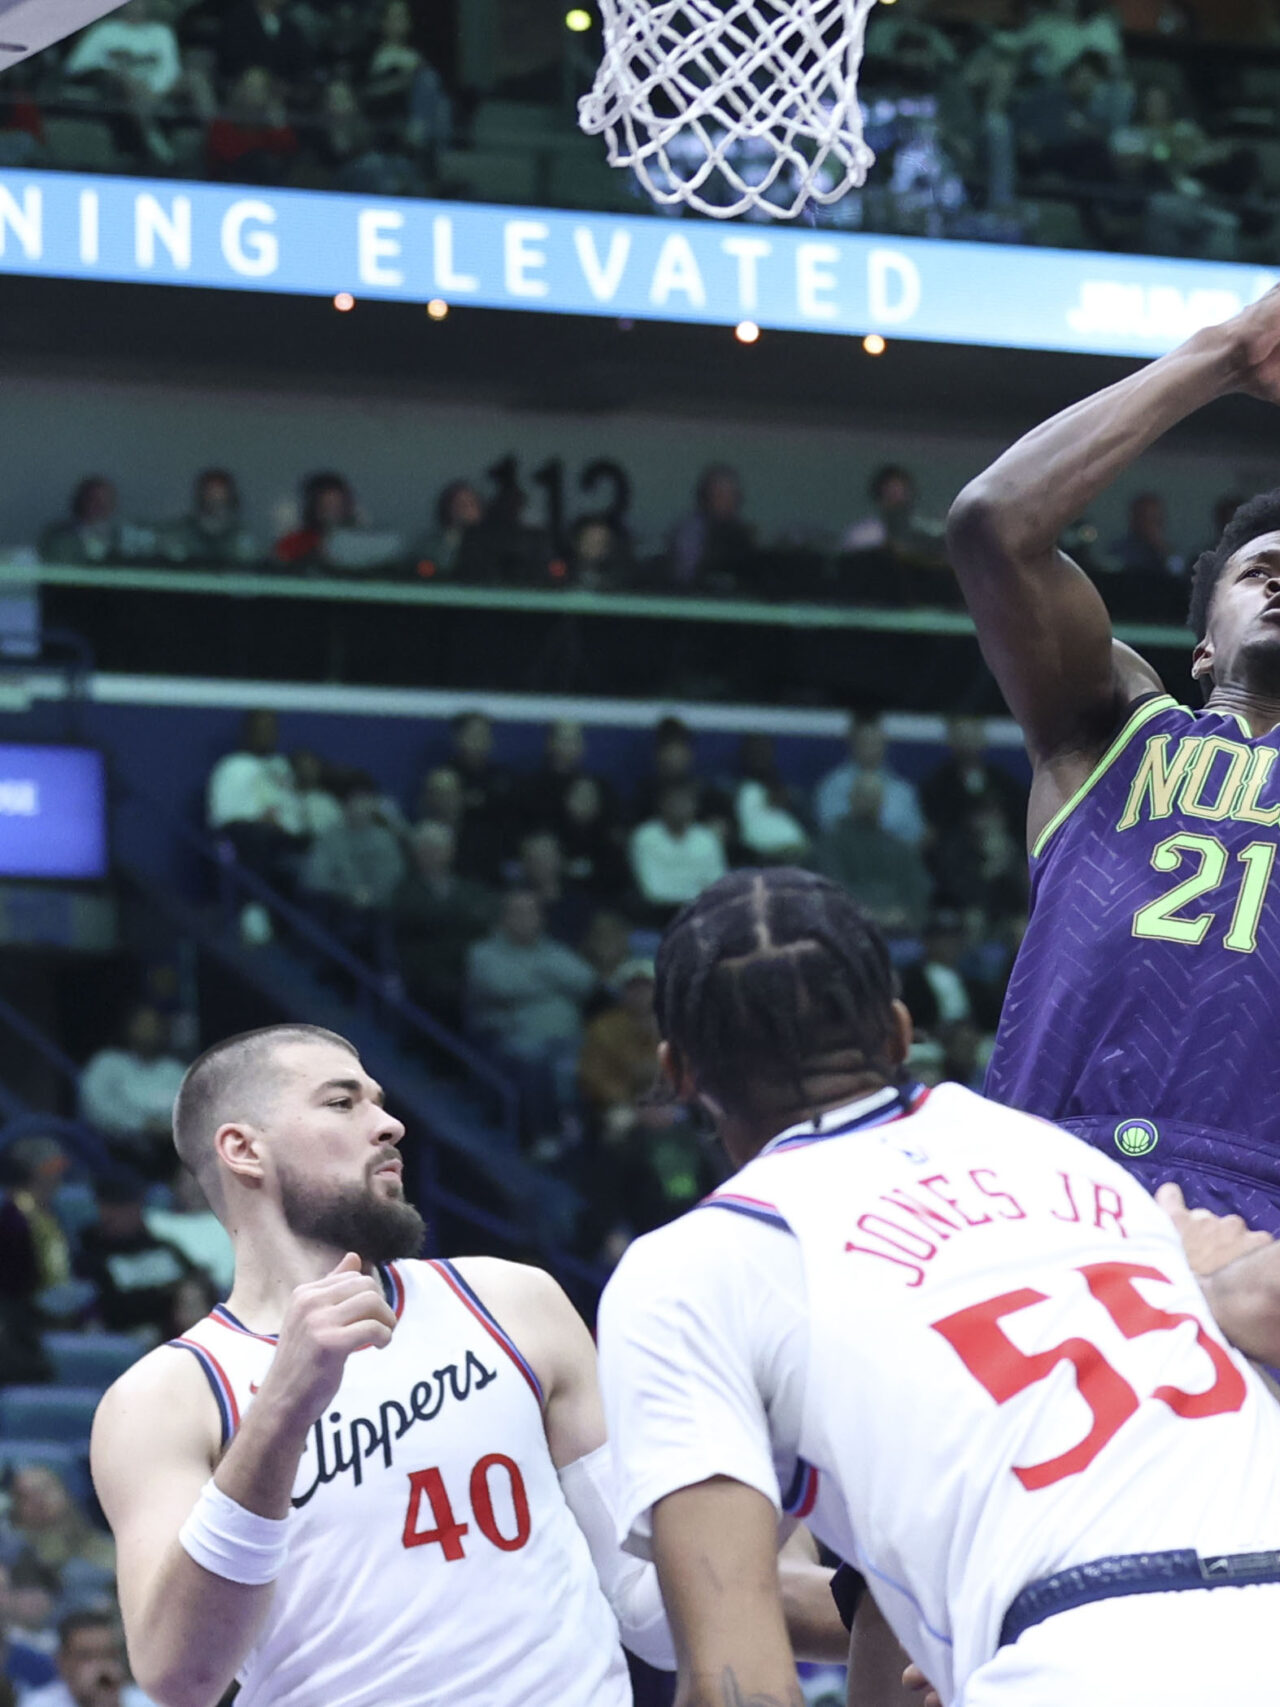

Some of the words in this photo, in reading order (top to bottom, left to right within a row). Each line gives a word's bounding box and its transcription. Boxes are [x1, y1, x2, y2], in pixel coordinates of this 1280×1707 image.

[0, 182, 280, 277] NING
[357, 209, 922, 324] ELEVATED
[1131, 831, 1277, 953] 21
[844, 1168, 1027, 1288] JONES
[1050, 1171, 1129, 1239] JR
[929, 1261, 1248, 1492] 55
[401, 1452, 532, 1562] 40
